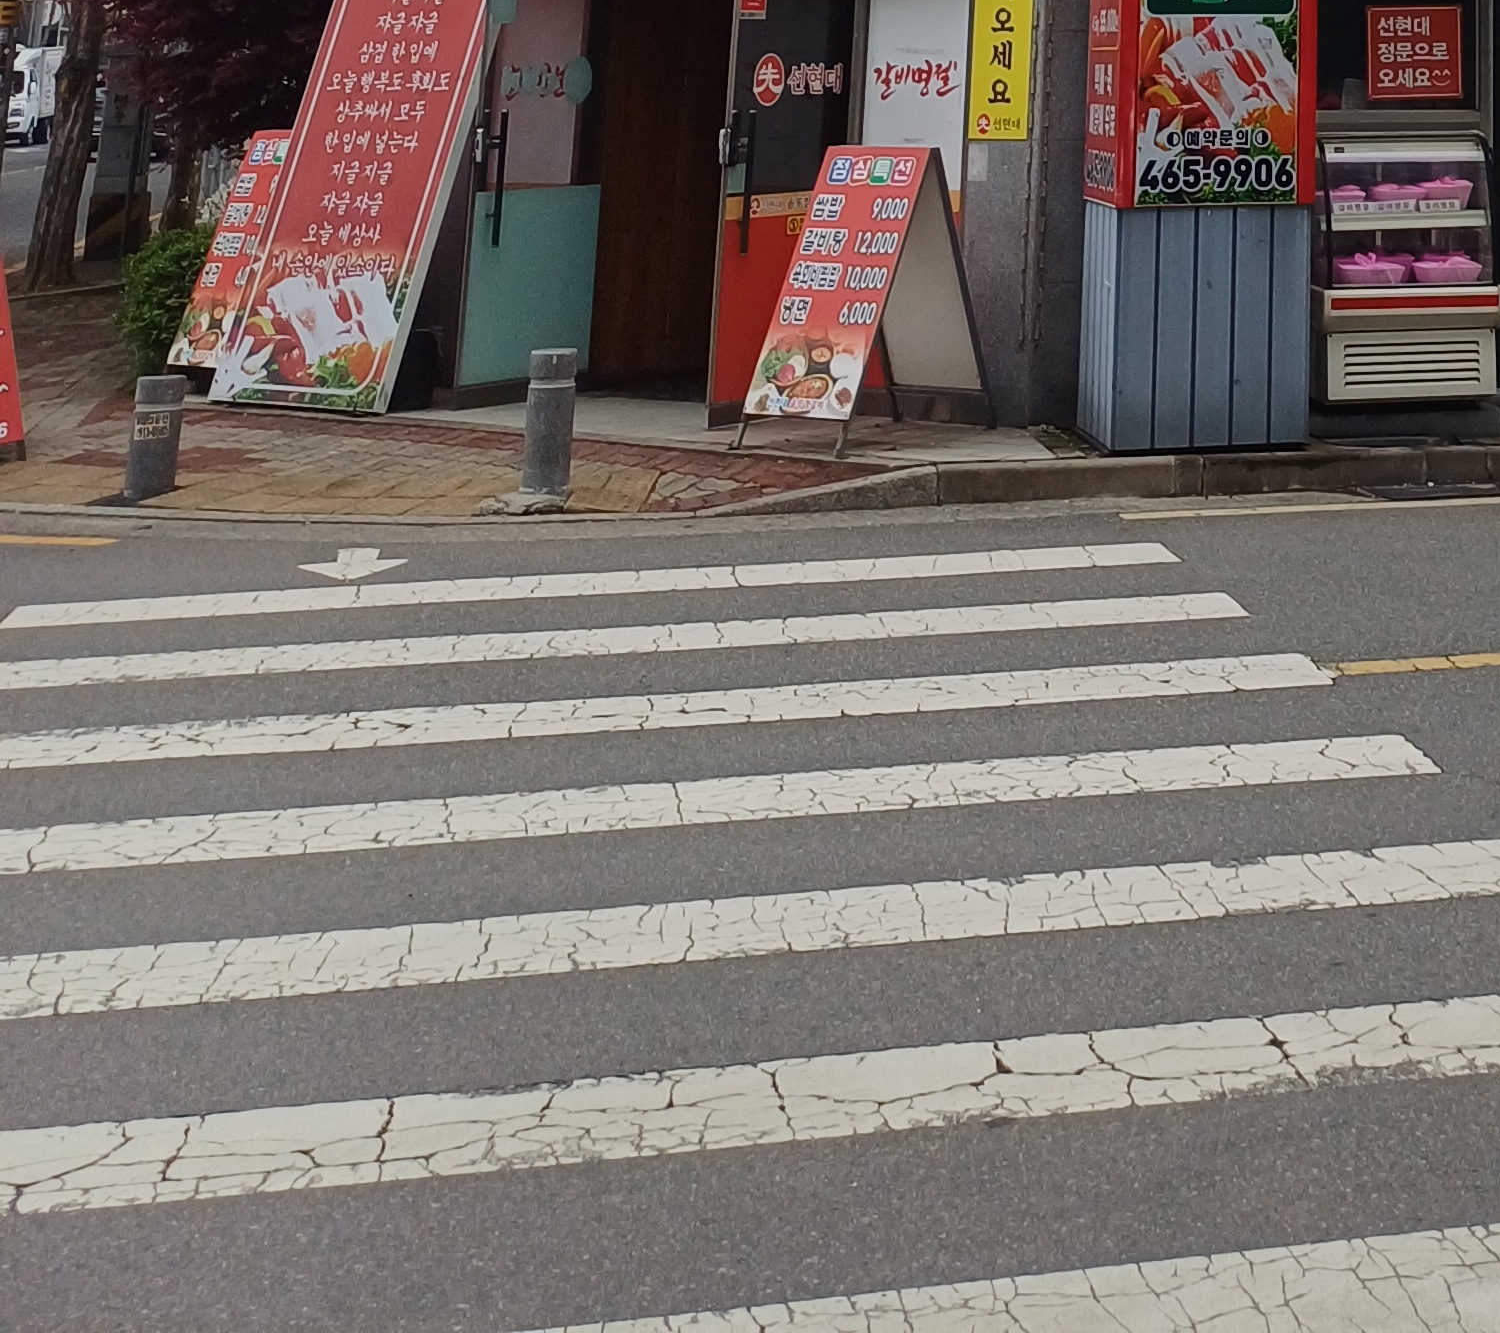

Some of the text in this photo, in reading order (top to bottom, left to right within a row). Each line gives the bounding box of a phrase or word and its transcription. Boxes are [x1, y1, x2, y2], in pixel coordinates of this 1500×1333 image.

[1377, 16, 1430, 37] 선현대
[1377, 41, 1449, 63] 정문으로
[327, 70, 358, 91] 오늘
[361, 70, 403, 93] 행복도
[787, 62, 843, 95] 선현대
[873, 59, 962, 101] 갈비명절
[1377, 68, 1432, 89] 오세요
[394, 101, 426, 123] 모두
[1184, 129, 1251, 149] 예약문의
[829, 157, 915, 184] 점심특선
[1139, 155, 1295, 193] 465-9906
[811, 194, 845, 221] 쌈밥
[872, 197, 908, 221] 9,000
[302, 222, 333, 245] 오늘
[800, 228, 898, 256] 갈비탕 12,000
[844, 266, 888, 291] 10,000
[780, 296, 877, 326] 냉면 6,000
